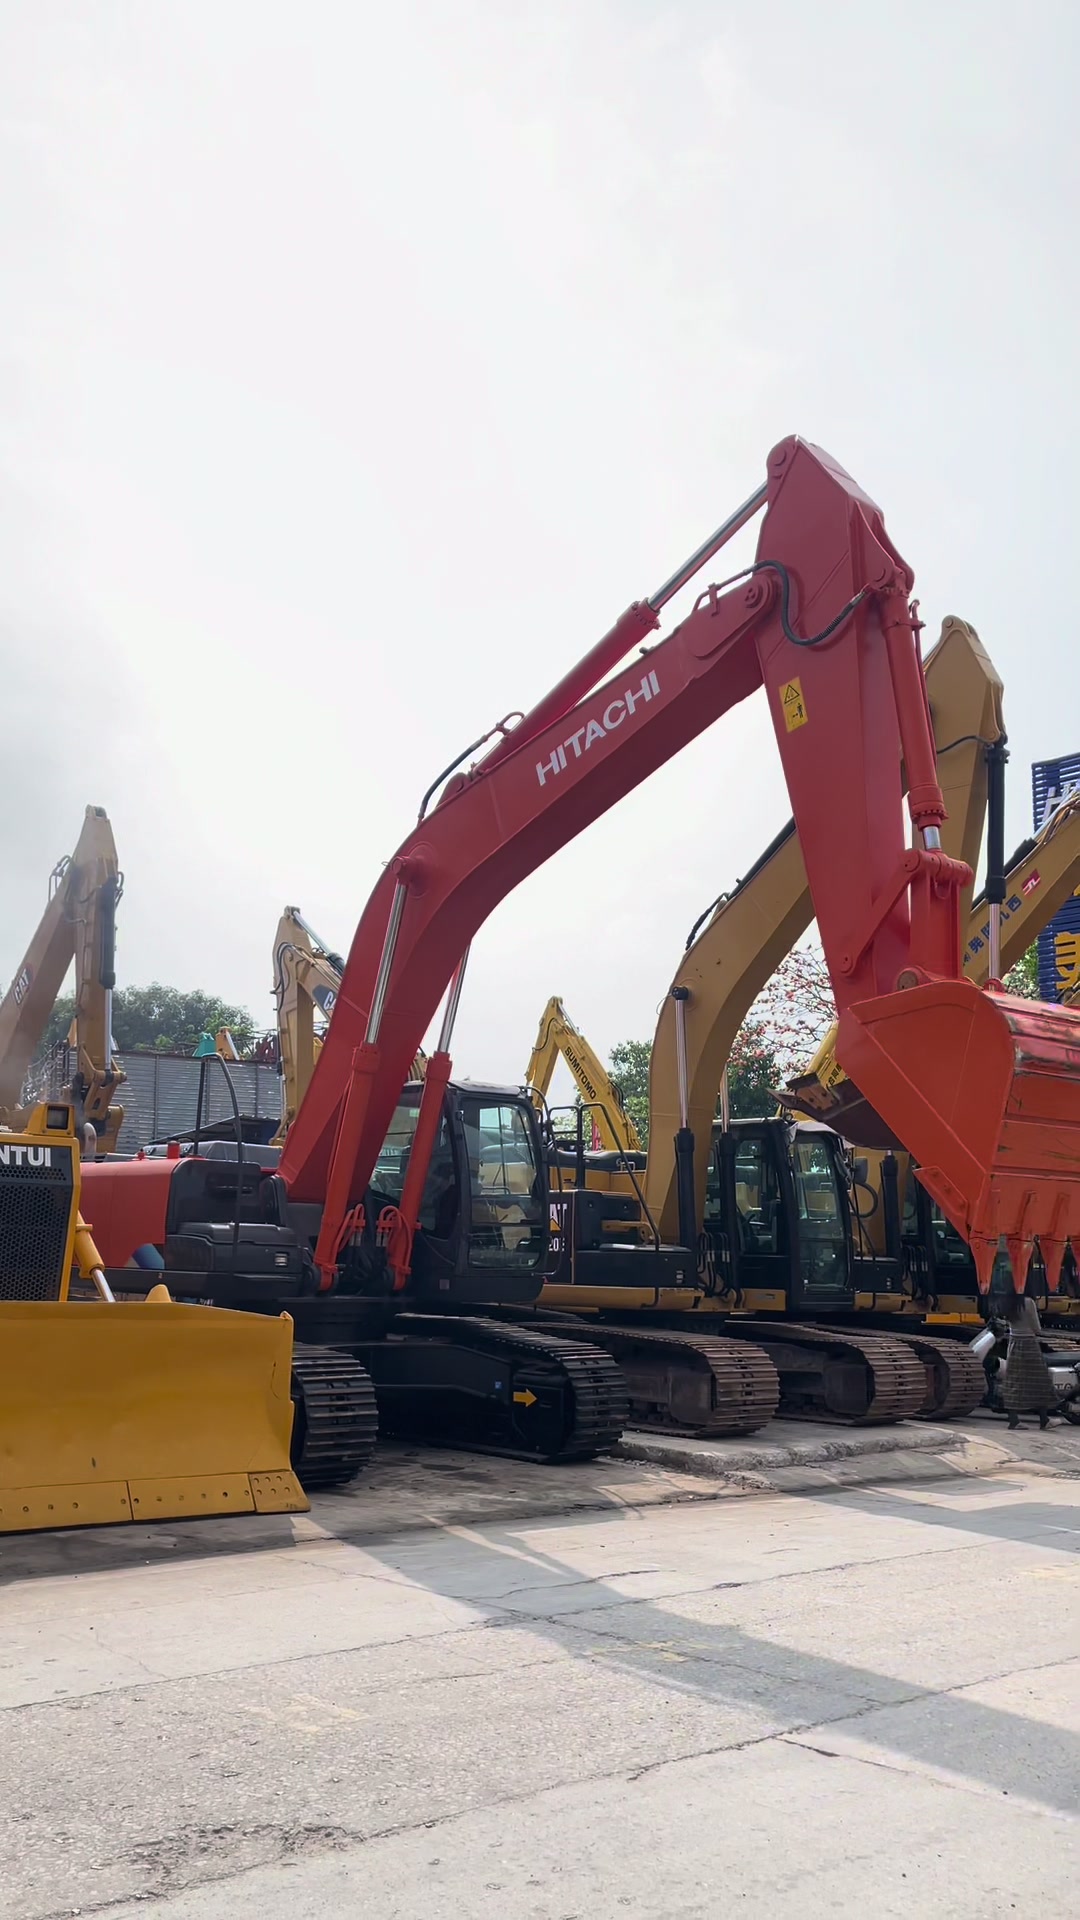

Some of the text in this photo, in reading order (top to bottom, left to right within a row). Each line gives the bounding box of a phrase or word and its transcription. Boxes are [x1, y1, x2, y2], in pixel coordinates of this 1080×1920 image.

[535, 669, 661, 786] HITACHI
[564, 1046, 597, 1100] SUMITOMO
[0, 1144, 52, 1167] NTUI
